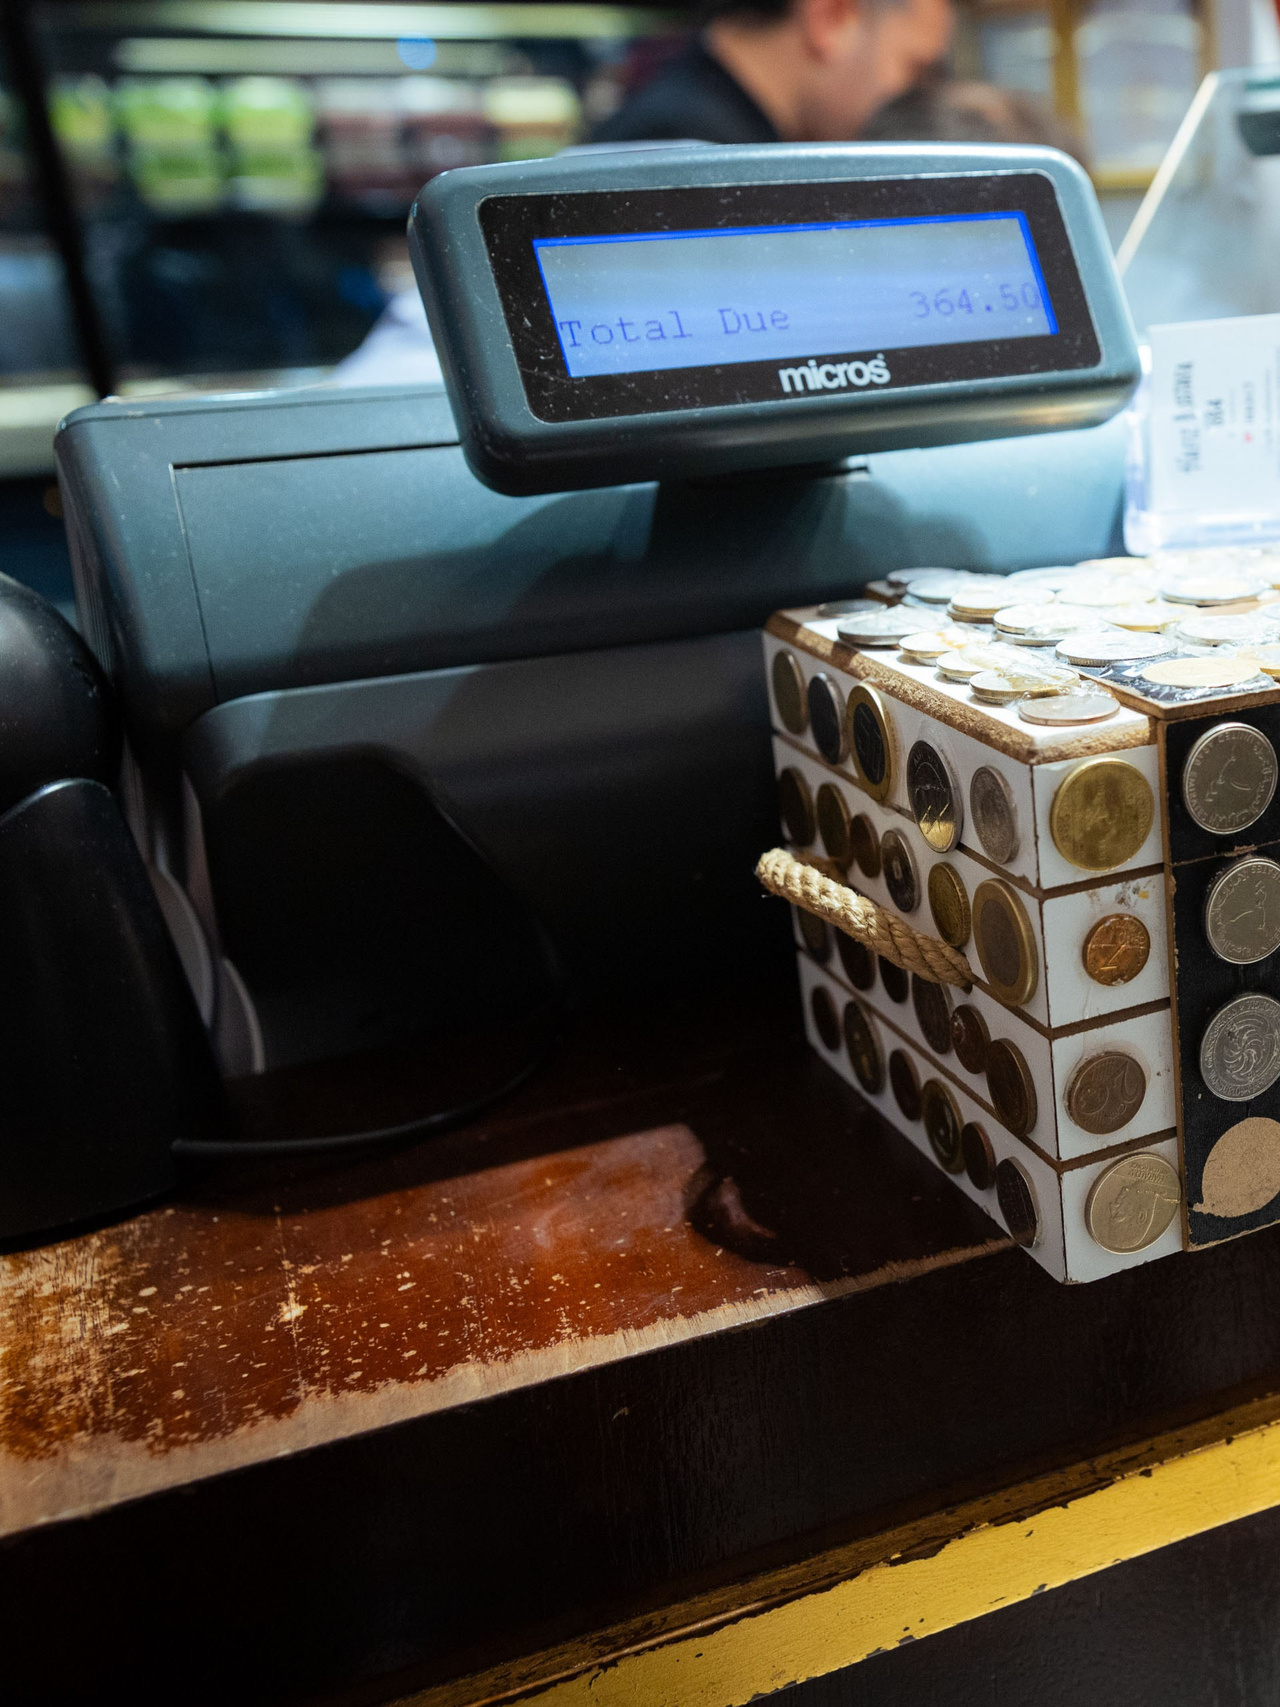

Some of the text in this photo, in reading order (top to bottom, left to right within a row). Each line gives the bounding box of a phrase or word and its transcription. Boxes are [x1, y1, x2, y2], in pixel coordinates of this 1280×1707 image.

[559, 283, 1042, 349] Total Due 364.50
